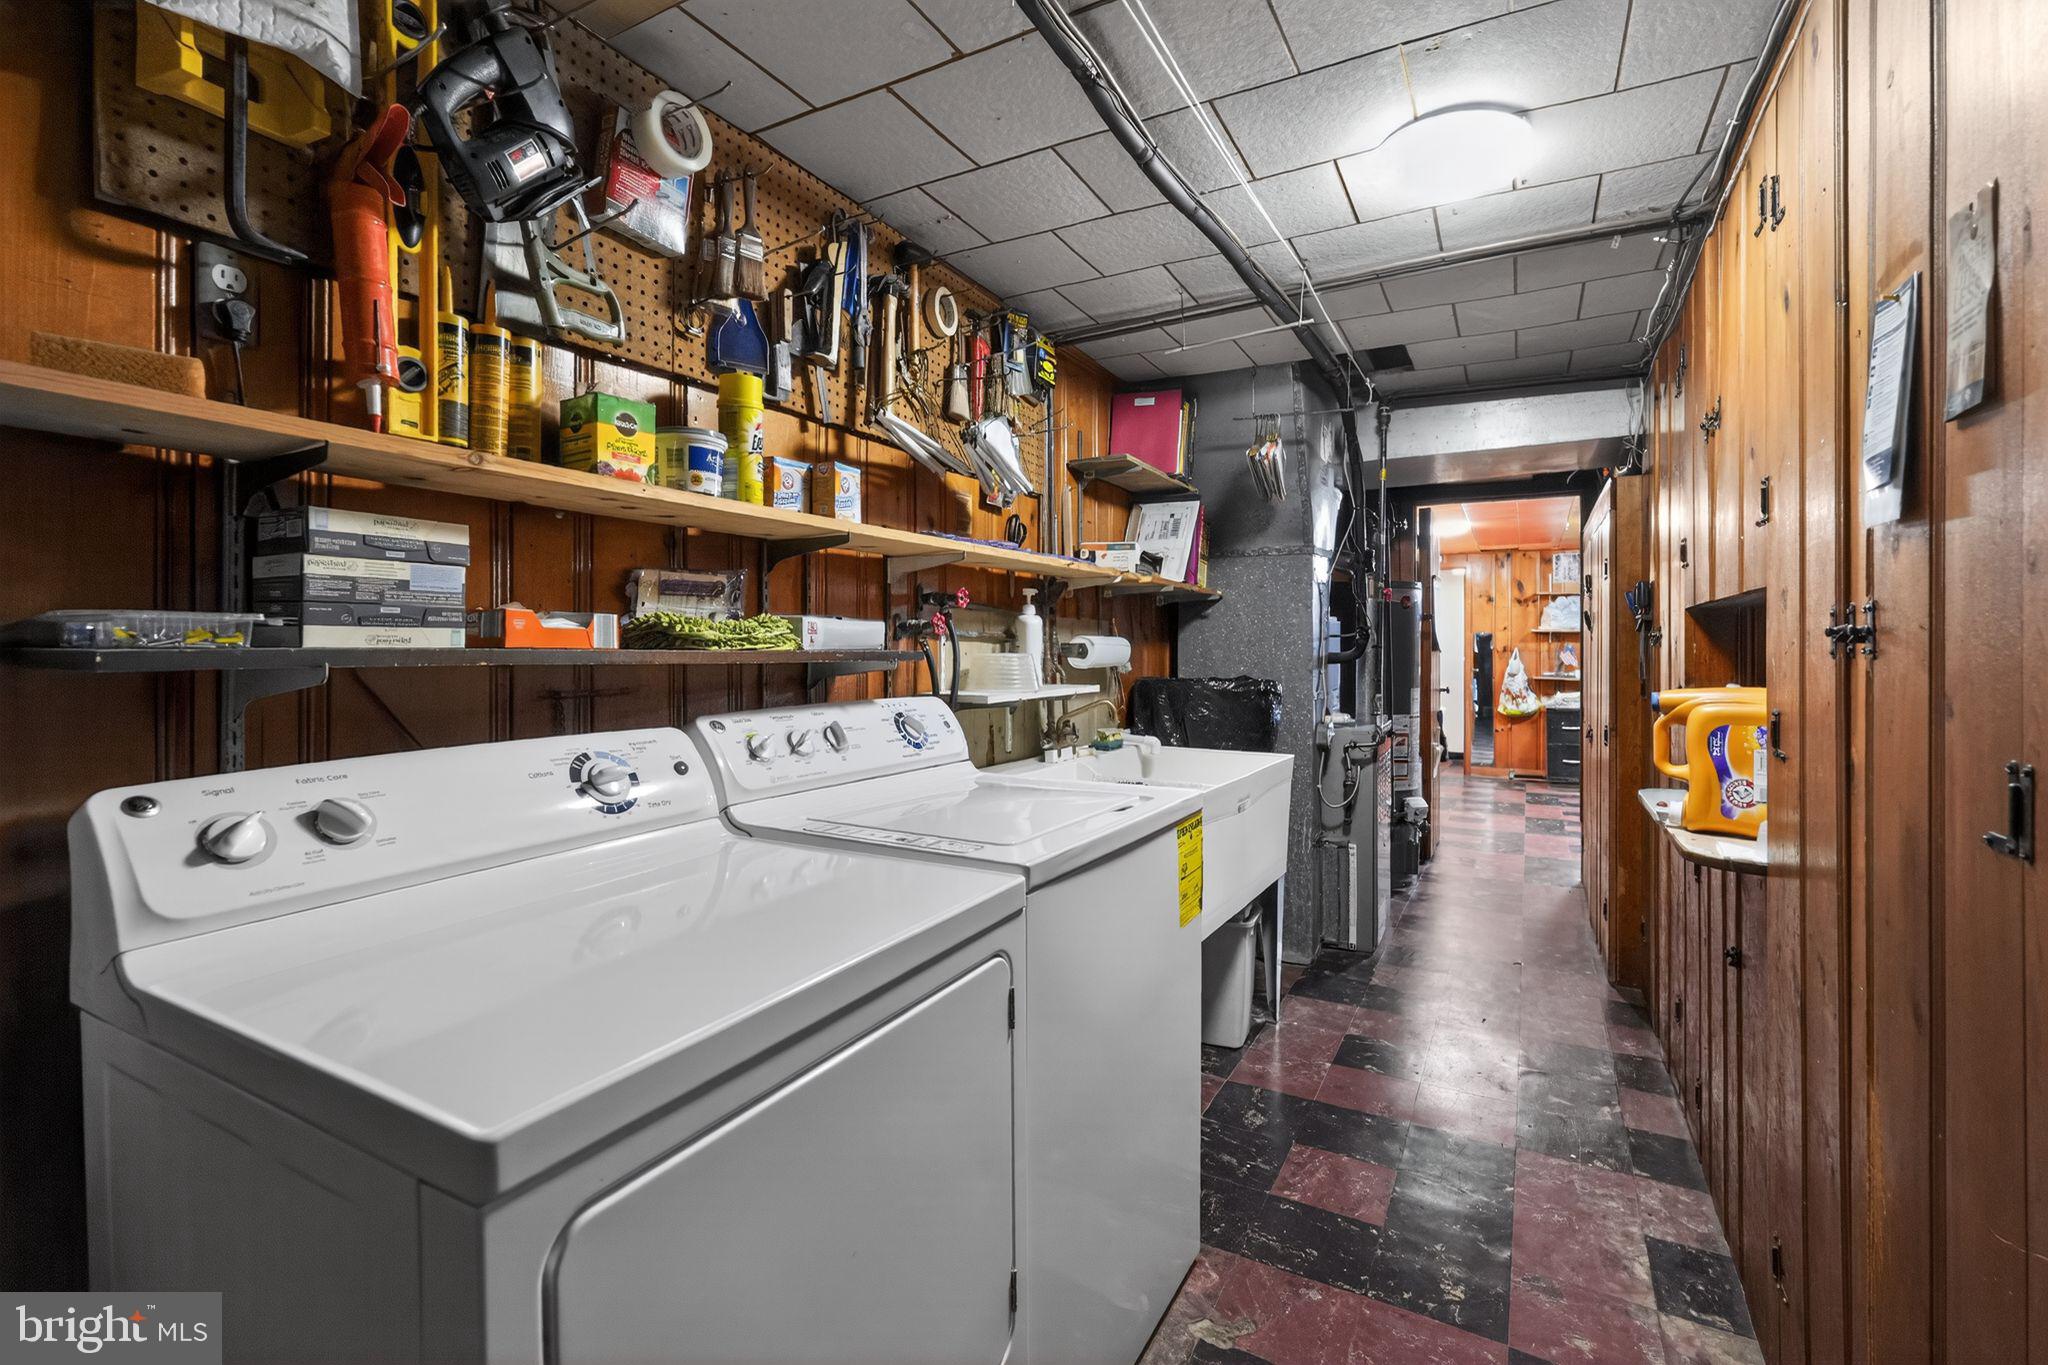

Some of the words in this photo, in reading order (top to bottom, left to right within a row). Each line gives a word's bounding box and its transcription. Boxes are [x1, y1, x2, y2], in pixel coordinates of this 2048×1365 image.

[295, 775, 326, 786] Fabric
[326, 772, 349, 783] Care
[201, 786, 235, 798] Signal
